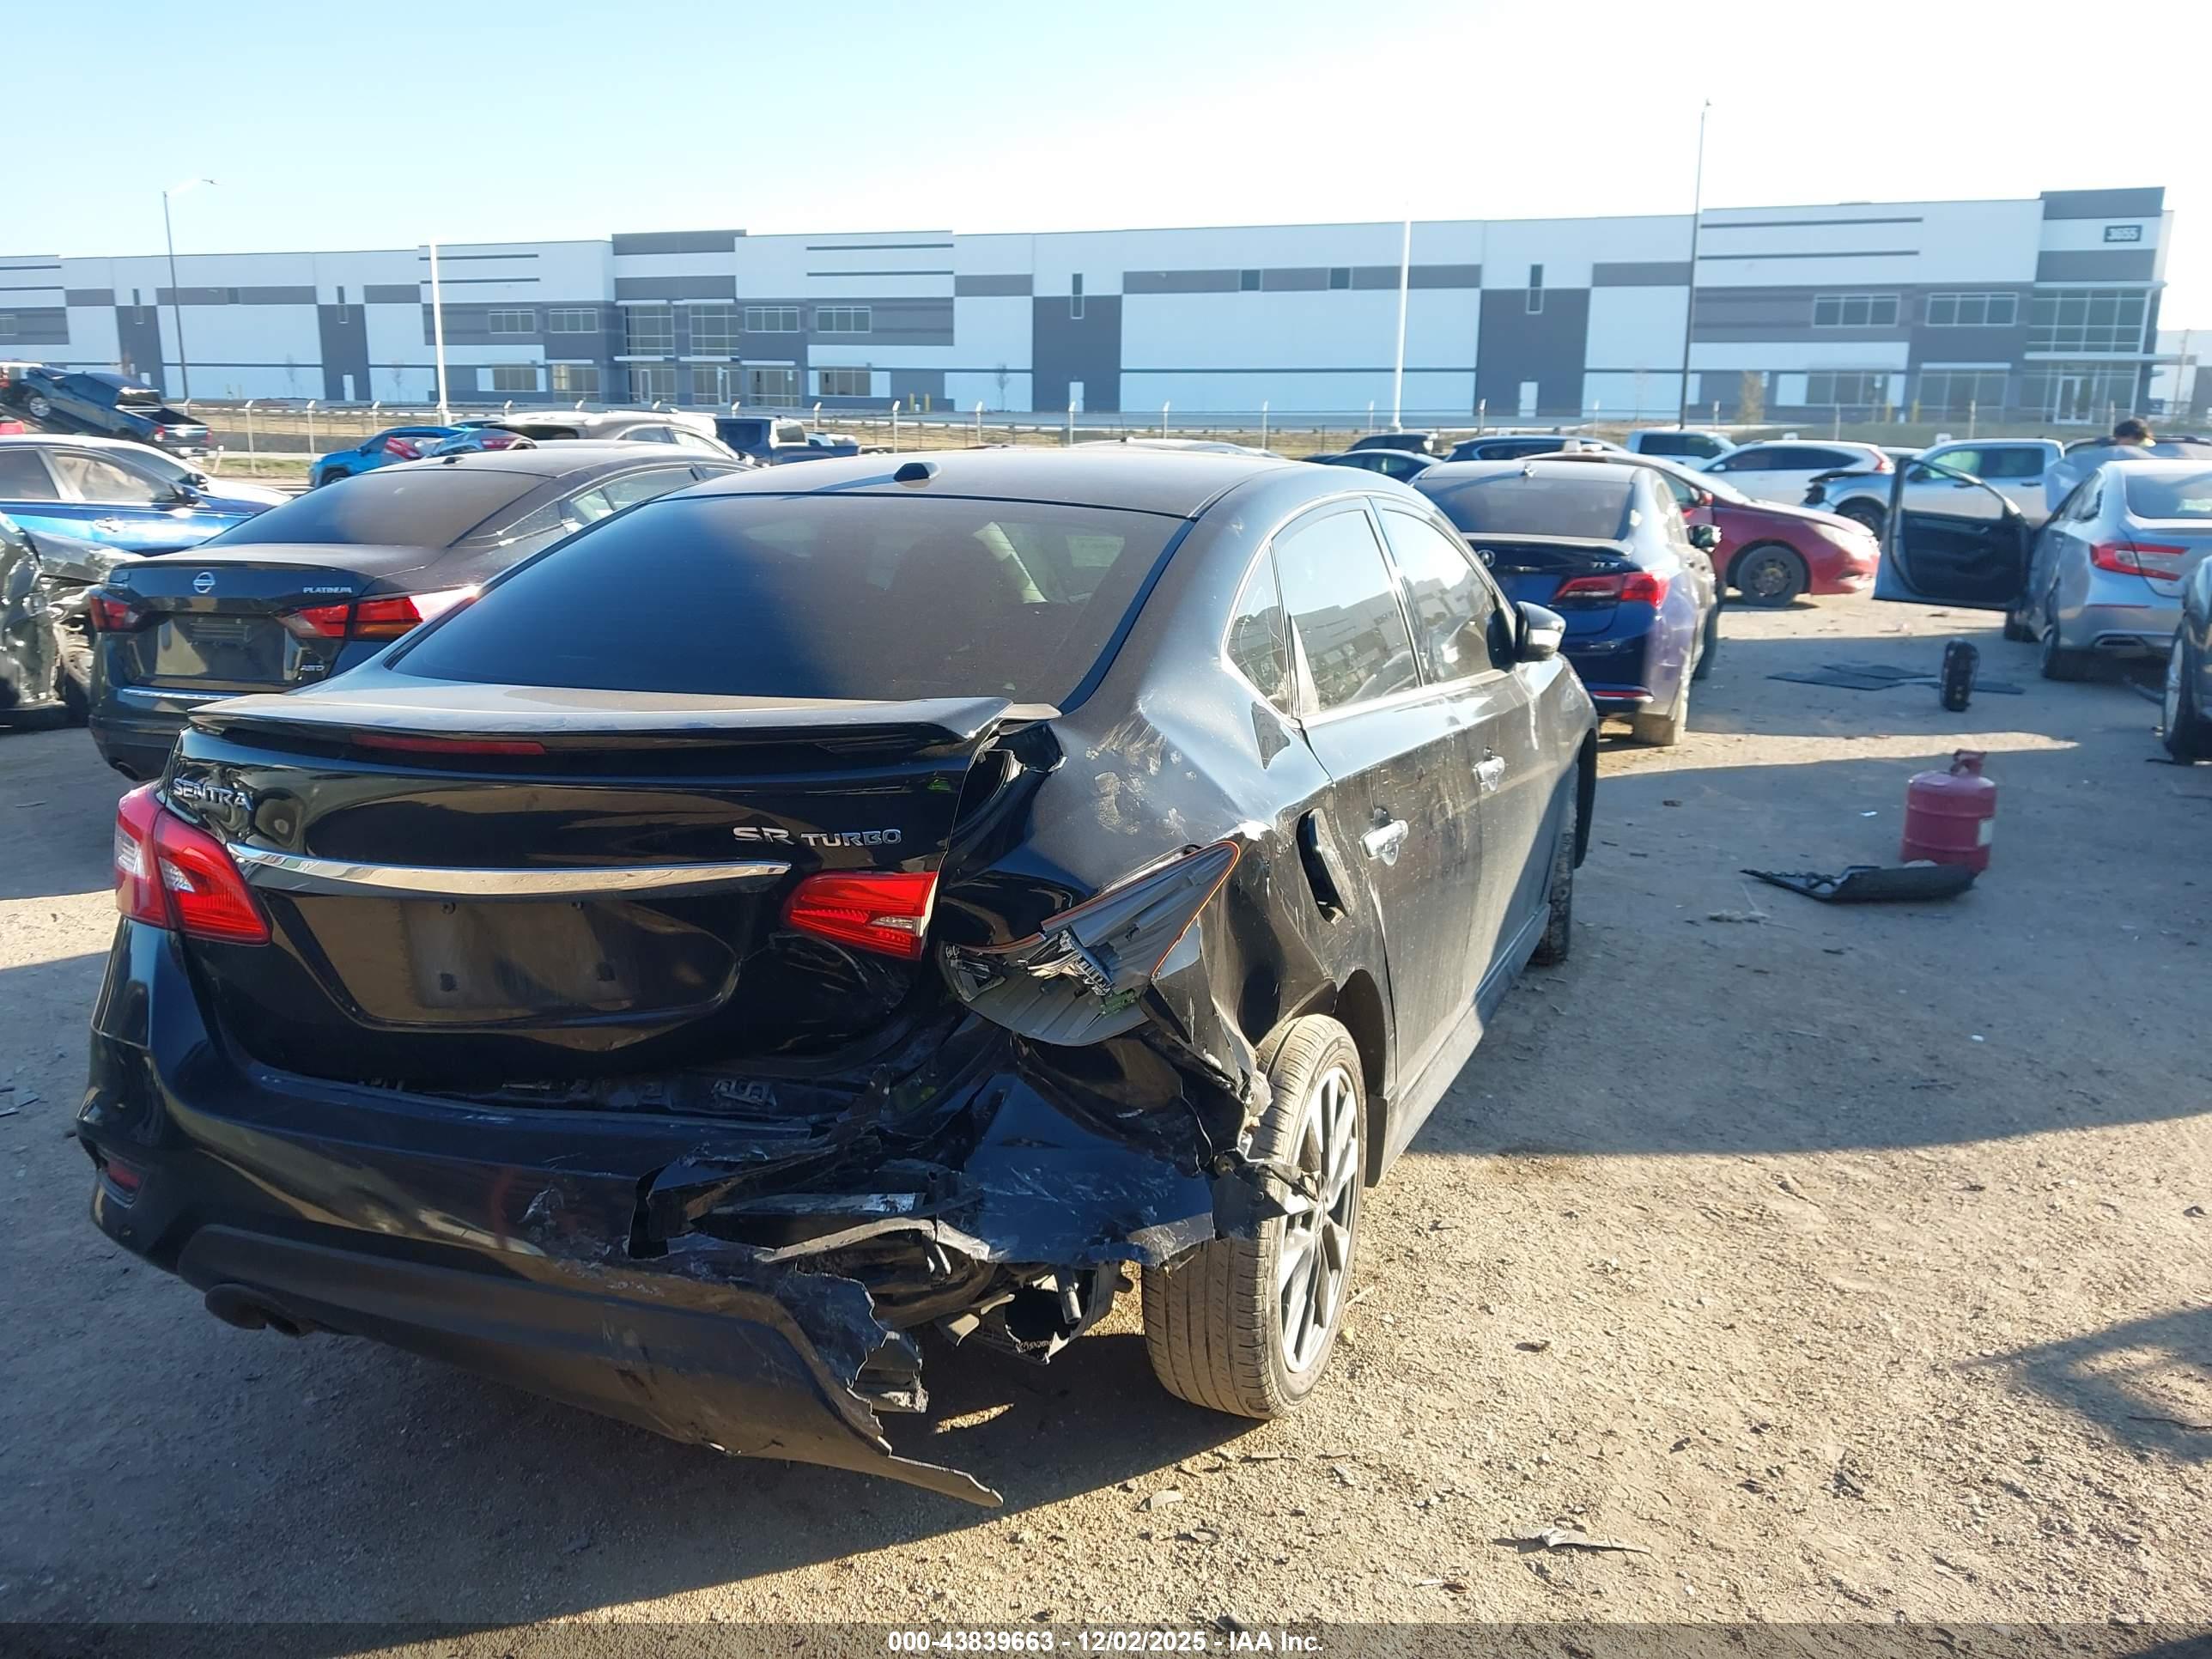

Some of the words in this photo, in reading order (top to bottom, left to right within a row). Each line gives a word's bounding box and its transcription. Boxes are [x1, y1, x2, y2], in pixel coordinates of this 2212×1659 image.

[173, 776, 254, 811] SENTRA
[732, 826, 795, 845] SR
[800, 829, 902, 847] TURBO
